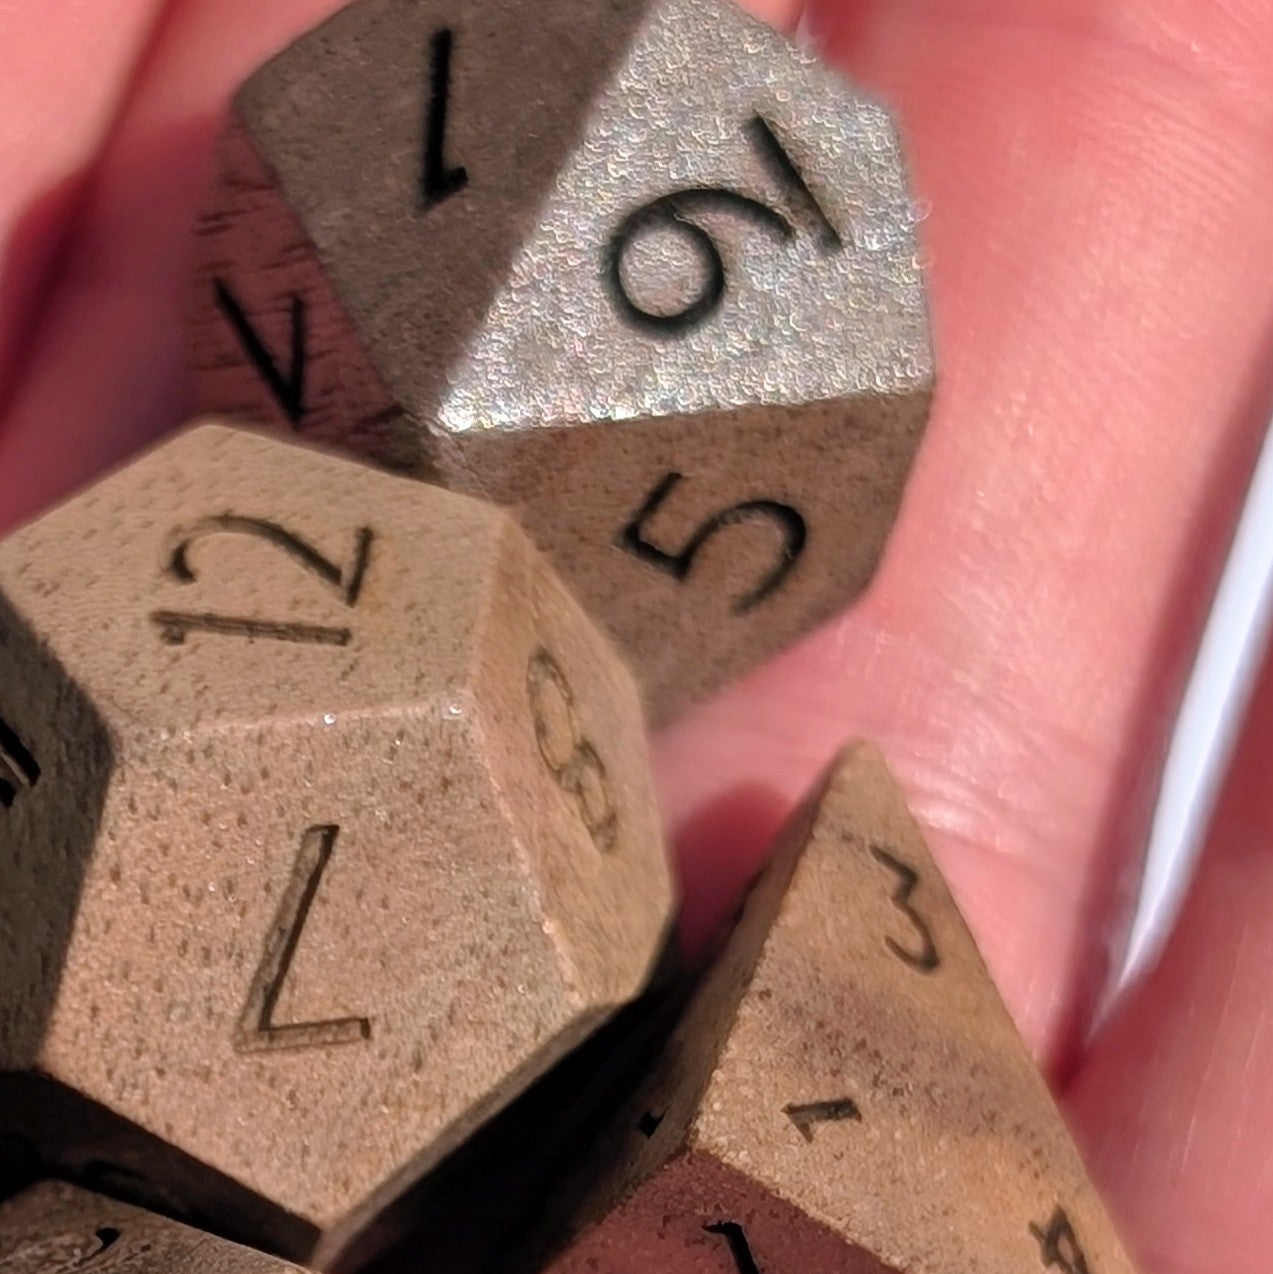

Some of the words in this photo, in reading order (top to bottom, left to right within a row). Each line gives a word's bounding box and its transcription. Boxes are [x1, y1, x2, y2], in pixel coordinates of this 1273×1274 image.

[418, 27, 469, 212] 1
[150, 510, 373, 647] 12
[617, 471, 807, 612] 5
[871, 845, 941, 974] 3
